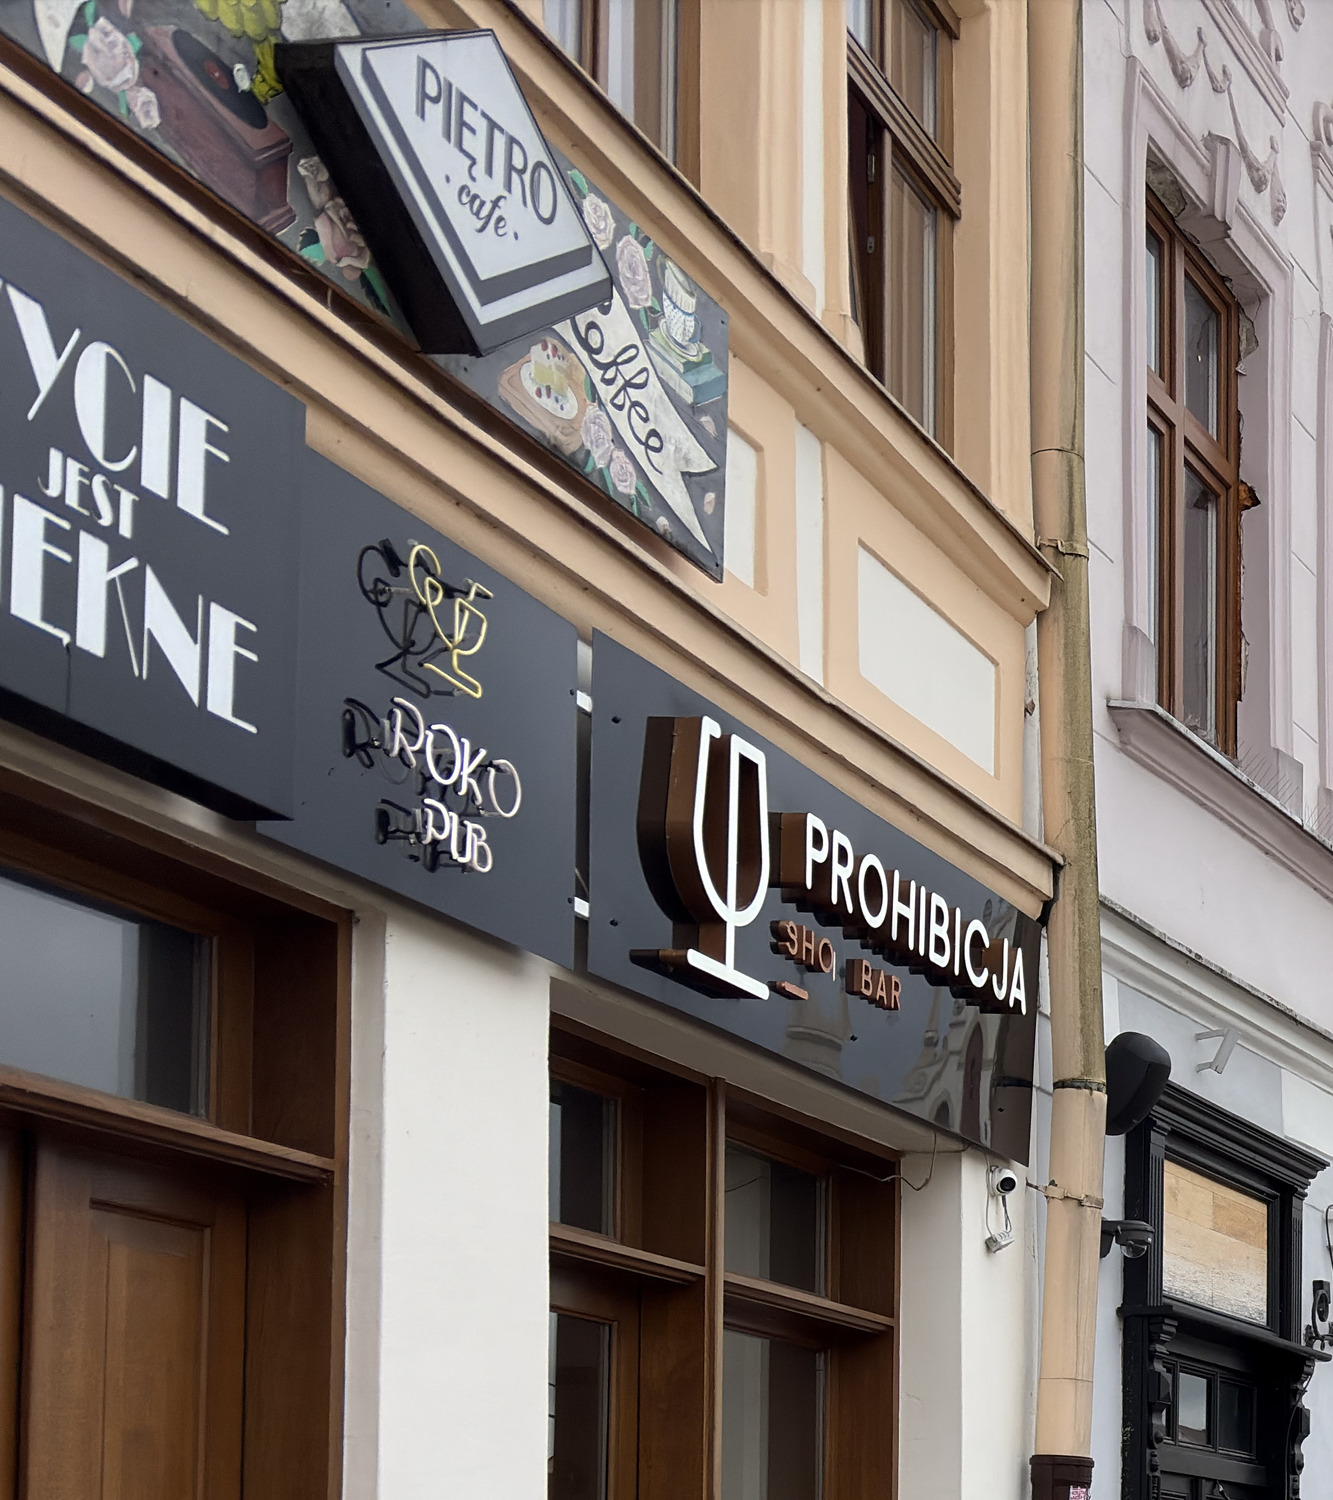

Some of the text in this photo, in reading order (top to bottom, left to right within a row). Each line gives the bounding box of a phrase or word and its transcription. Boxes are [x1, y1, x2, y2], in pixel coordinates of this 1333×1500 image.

[415, 54, 557, 226] PIĘTRO
[0, 278, 230, 537] YCIE
[38, 446, 140, 540] JEST
[391, 697, 522, 818] ROKO
[422, 798, 493, 873] PUB
[805, 812, 1027, 1016] PROHIBICJA
[861, 959, 902, 1010] BAR
